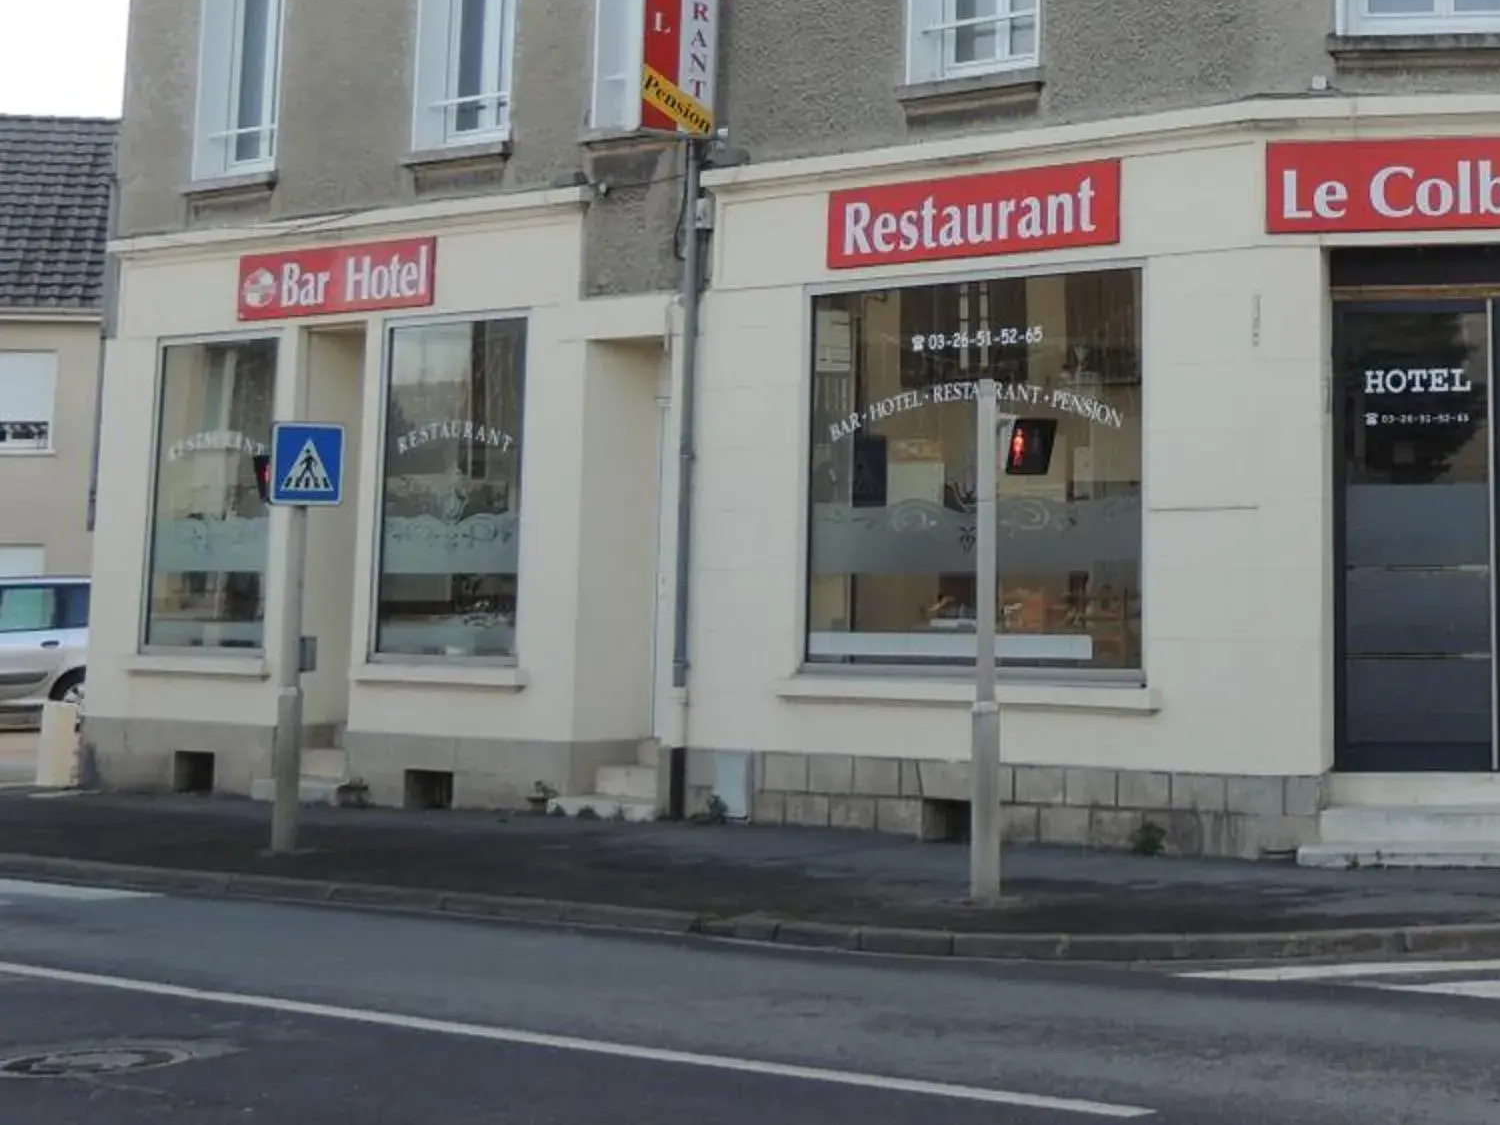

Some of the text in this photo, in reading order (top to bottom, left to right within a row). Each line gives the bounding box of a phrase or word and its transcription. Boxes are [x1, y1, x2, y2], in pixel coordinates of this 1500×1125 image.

[644, 74, 711, 134] Pension
[842, 175, 1097, 256] Restaurant
[1283, 169, 1348, 219] Le
[280, 245, 428, 308] Bar Hotel
[1364, 368, 1472, 394] HOTEL
[398, 419, 513, 455] RESTAURANT
[829, 381, 1123, 442] BAR HOTEL RESTARANT PENSION
